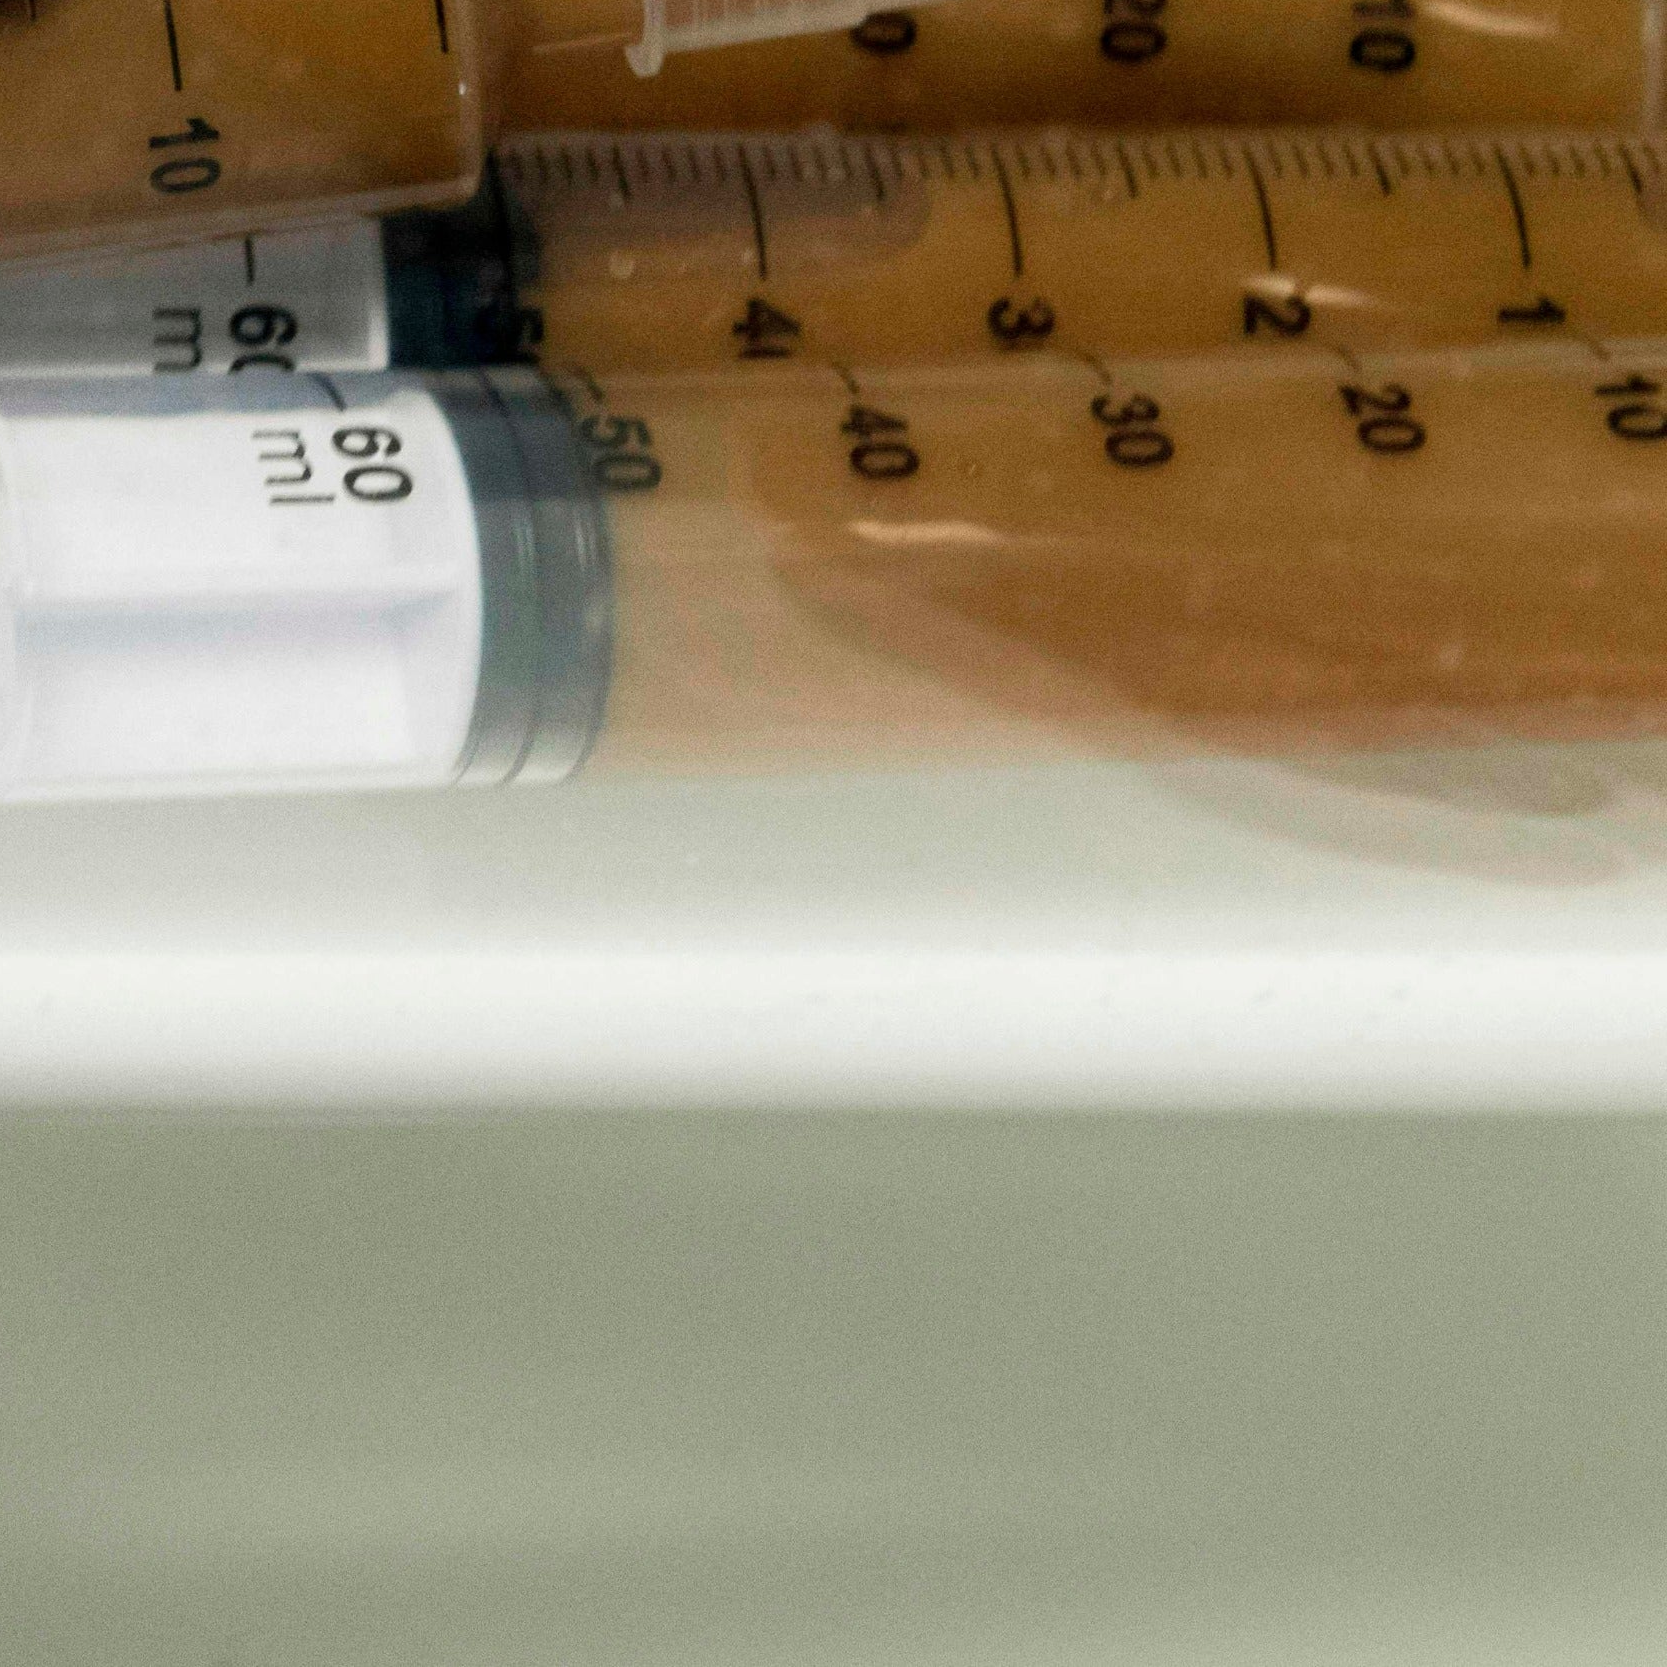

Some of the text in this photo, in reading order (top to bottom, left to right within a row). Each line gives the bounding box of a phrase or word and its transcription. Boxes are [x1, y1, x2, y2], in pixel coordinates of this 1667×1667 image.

[850, 9, 919, 56] 0
[148, 116, 223, 196] 10
[152, 306, 203, 375] m
[839, 404, 921, 480] 40
[1090, 392, 1176, 469] 30
[1338, 382, 1427, 456] 20
[1594, 374, 1667, 442] 10
[251, 430, 336, 505] ml
[331, 424, 414, 504] 60
[580, 412, 664, 493] 50
